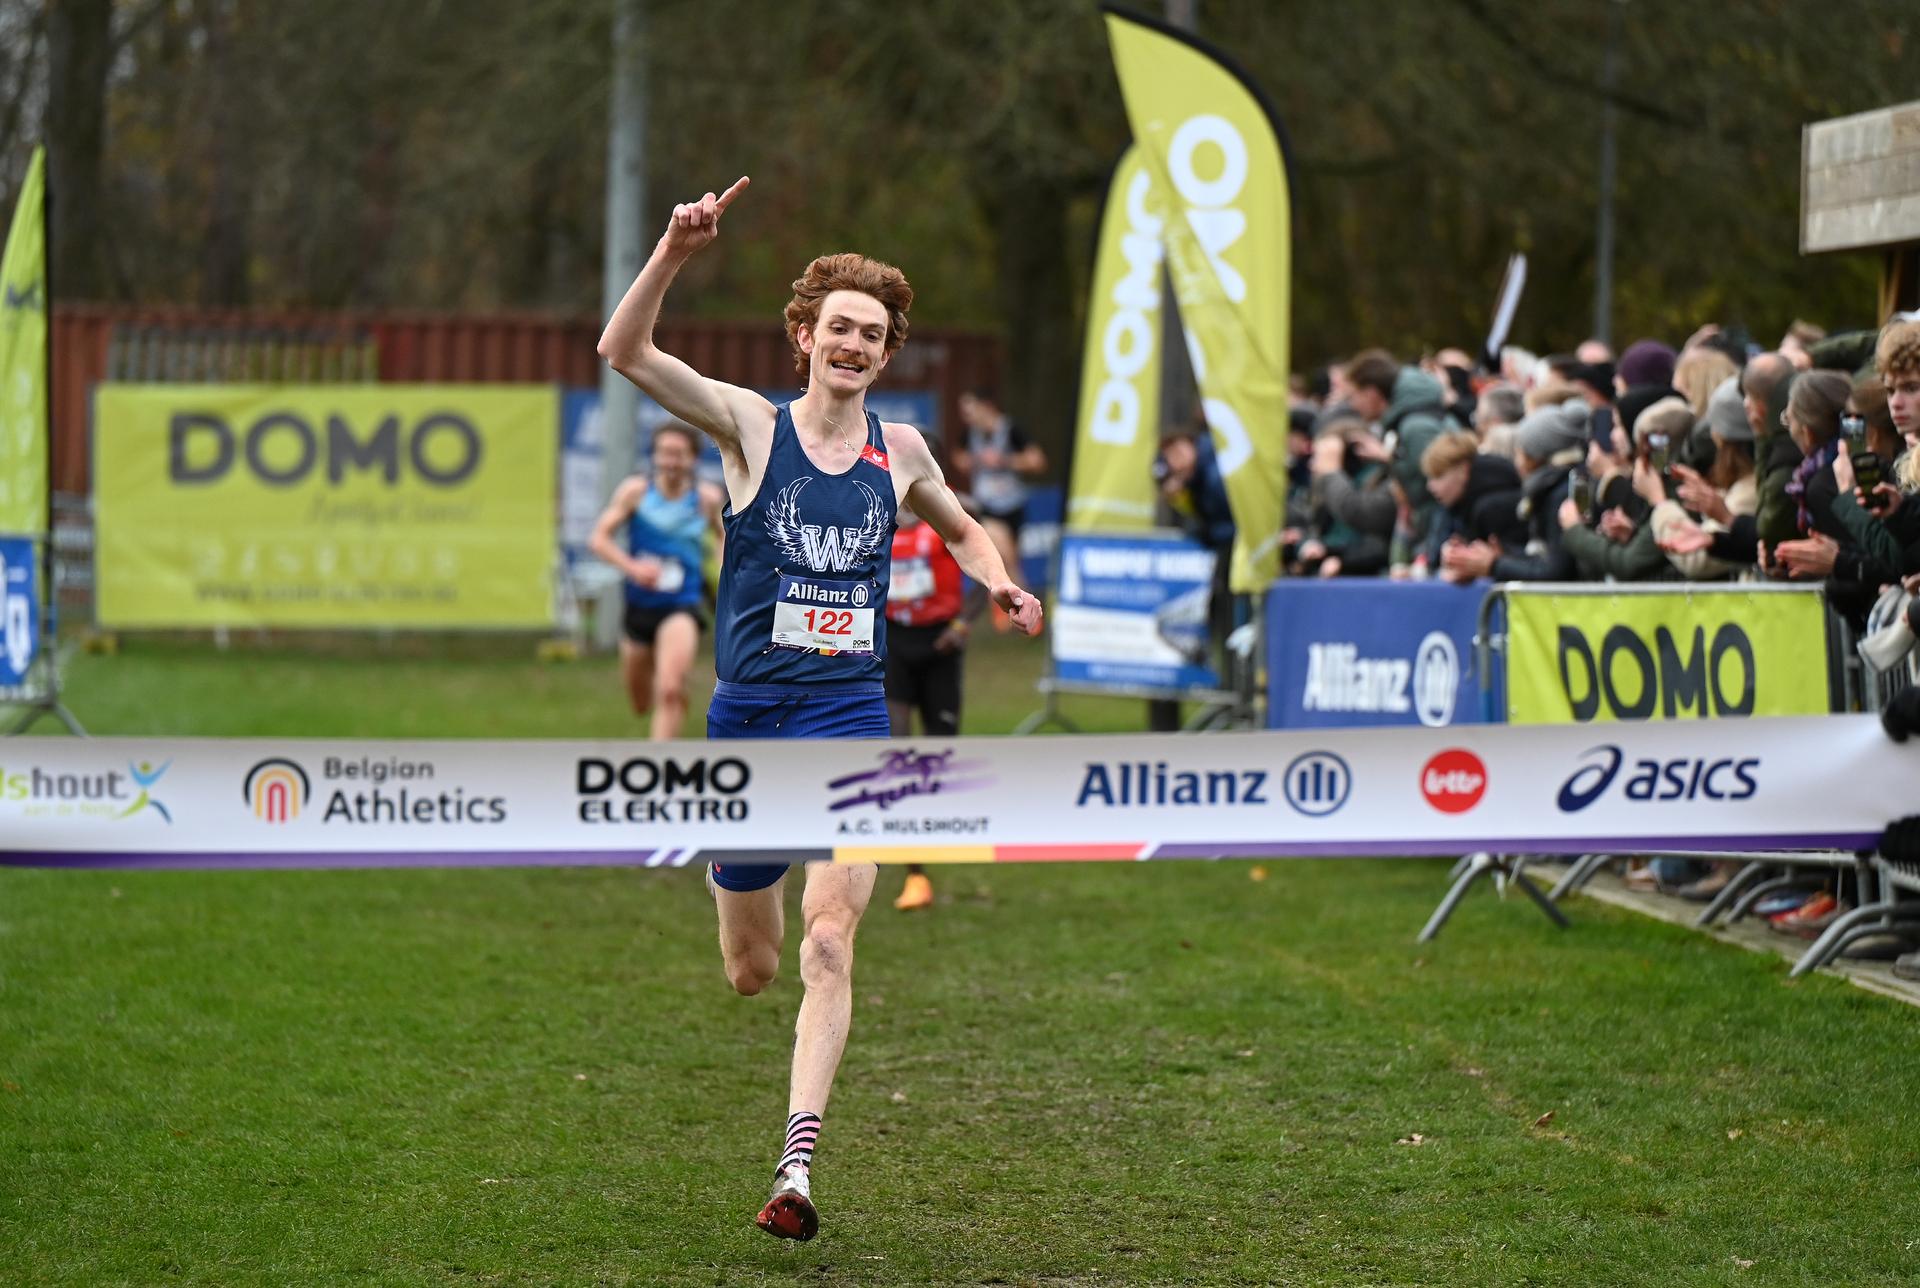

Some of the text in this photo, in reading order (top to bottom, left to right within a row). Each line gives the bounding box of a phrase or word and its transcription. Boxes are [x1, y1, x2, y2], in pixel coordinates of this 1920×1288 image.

[168, 410, 483, 489] DOMO
[786, 582, 849, 604] Allianz
[803, 608, 854, 636] 122
[1303, 641, 1411, 713] Allianz
[1557, 621, 1756, 722] DOMO
[323, 758, 434, 782] Belgian
[577, 757, 751, 796] DOMO
[1076, 762, 1268, 806] Allianz
[323, 787, 506, 824] Athletics
[578, 799, 748, 822] ELEKTRO
[883, 817, 988, 834] HULSHOUT
